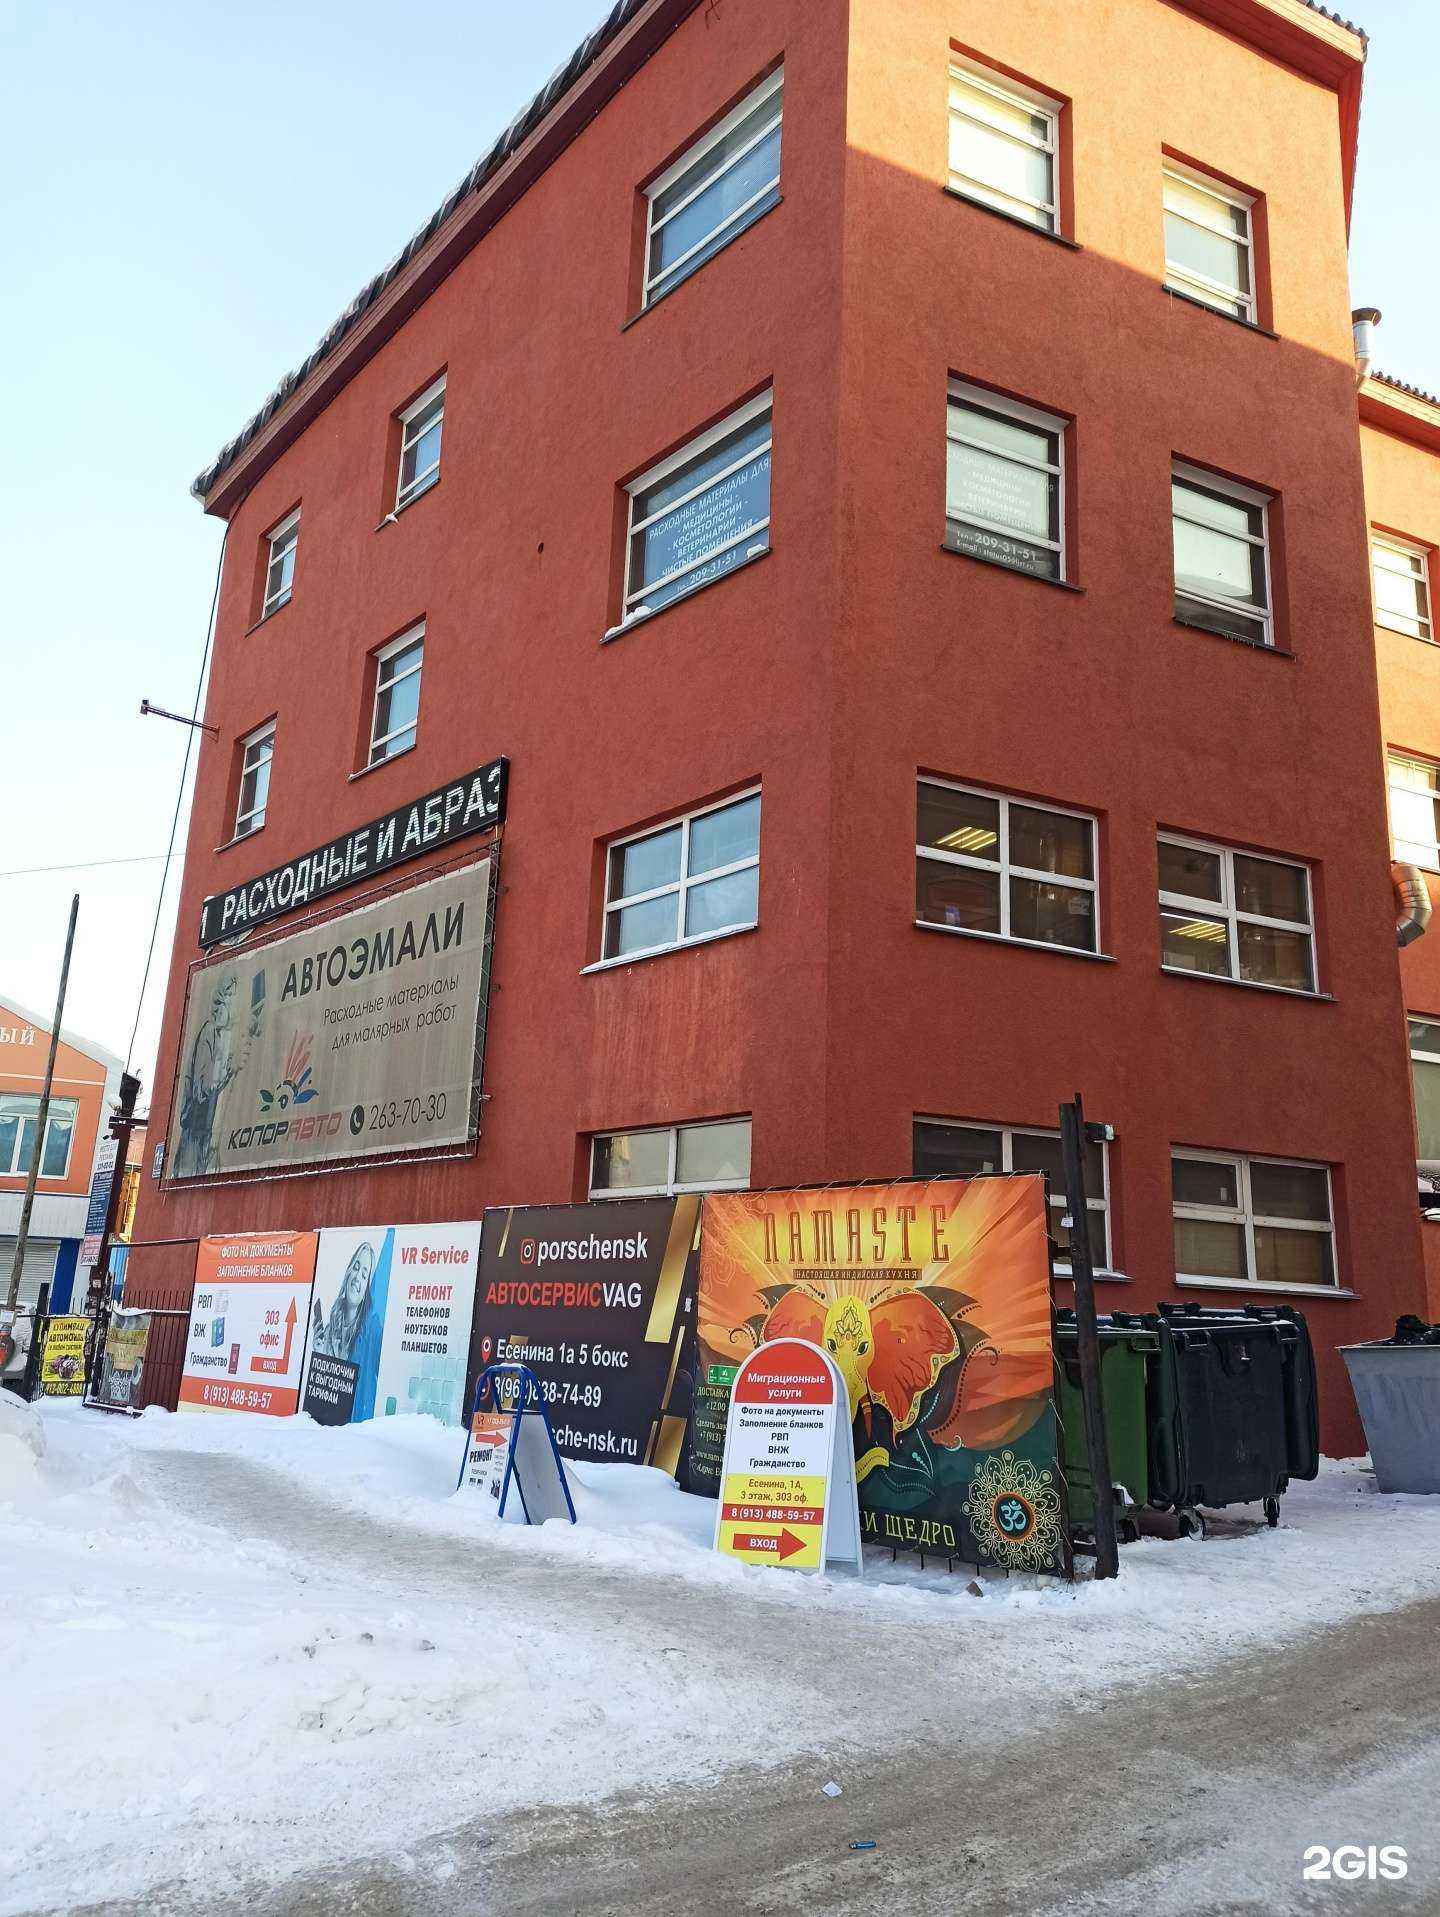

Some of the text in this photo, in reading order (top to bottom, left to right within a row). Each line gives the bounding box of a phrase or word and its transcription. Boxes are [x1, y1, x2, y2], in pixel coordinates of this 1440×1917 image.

[649, 459, 769, 540] РАСХОДНЫЕ МАТЕРИАЛЫ ДЛЯ
[682, 496, 733, 532] МЕДИЦИНЫ
[672, 502, 742, 550] КОСМЕТОЛОГИИ
[677, 518, 736, 559] ВЕТЕРИНАРИИ
[975, 532, 1037, 561] 209-31-51
[690, 551, 736, 585] 209-31-51
[221, 766, 501, 930] РАСХОДНЫЕ И АБРАЗ
[281, 902, 465, 1002] АВТОЭМАЛИ
[323, 974, 459, 1026] Расходные материалы
[331, 1003, 457, 1051] для малярных работ
[368, 1092, 447, 1131] 263-70-30
[763, 1204, 950, 1264] NAMASTE
[221, 1243, 294, 1260] ФОТО НА ДОКУМЕНТЫ
[401, 1245, 469, 1265] VR Service
[537, 1232, 648, 1266] porschensk
[216, 1263, 293, 1277] ЗАПОЛНЕНИЕ БЛАНКОВ
[795, 1270, 919, 1280] НАСТОЯЩАЯ ИНДИЙСКАЯ КУХНЯ
[198, 1295, 212, 1309] РВП
[408, 1285, 453, 1301] РЕМОНТ
[265, 1310, 280, 1325] 303
[406, 1306, 450, 1319] ТЕЛЕФОНОВ
[260, 1330, 280, 1350] офис
[404, 1323, 448, 1337] НОУТБУКОВ
[401, 1340, 448, 1355] ПЛАНШЕТОВ
[497, 1339, 629, 1368] Есенина 1а 5 бокс
[191, 1352, 228, 1368] Гражданство
[312, 1357, 355, 1380] ПОДКЛЮЧИМ
[309, 1371, 354, 1395] К ВЫГОДНЫМ
[747, 1373, 826, 1385] Миграционные
[203, 1384, 272, 1409] 8 (913) 488-59-57
[308, 1384, 339, 1405] ТАРИФАМ
[768, 1389, 802, 1399] услуги
[741, 1406, 762, 1415] Фото
[776, 1408, 824, 1417] документы
[739, 1419, 824, 1428] Заполнение бланков
[771, 1432, 789, 1441] РВП
[768, 1445, 789, 1454] ВНЖ
[749, 1458, 806, 1468] Гражданство
[748, 1478, 804, 1491] Есенина, 1А,
[740, 1491, 809, 1504] 3 этаж, 303 оф.
[731, 1508, 816, 1521] 8 (913) 488-59-57
[885, 1514, 955, 1547] ЩЕДРО
